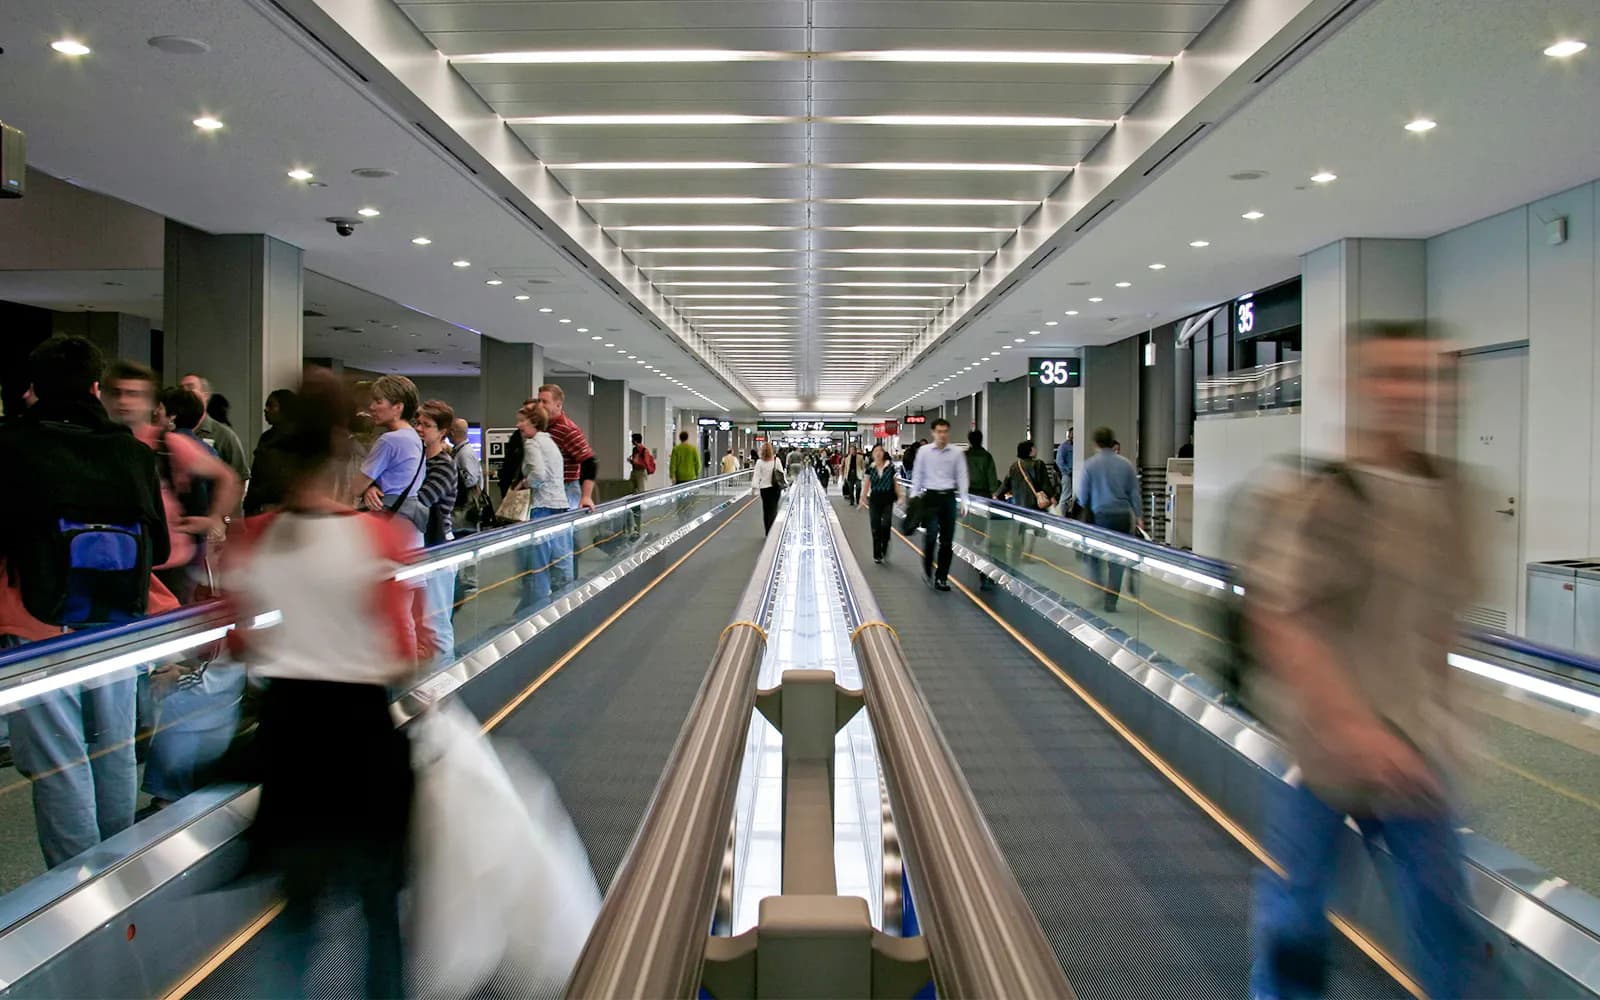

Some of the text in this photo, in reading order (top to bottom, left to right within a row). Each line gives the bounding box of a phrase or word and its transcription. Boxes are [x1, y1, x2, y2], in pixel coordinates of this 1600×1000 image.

[1238, 302, 1254, 333] 35
[1040, 360, 1068, 385] 35
[797, 422, 825, 431] 37-47
[492, 443, 501, 456] P
